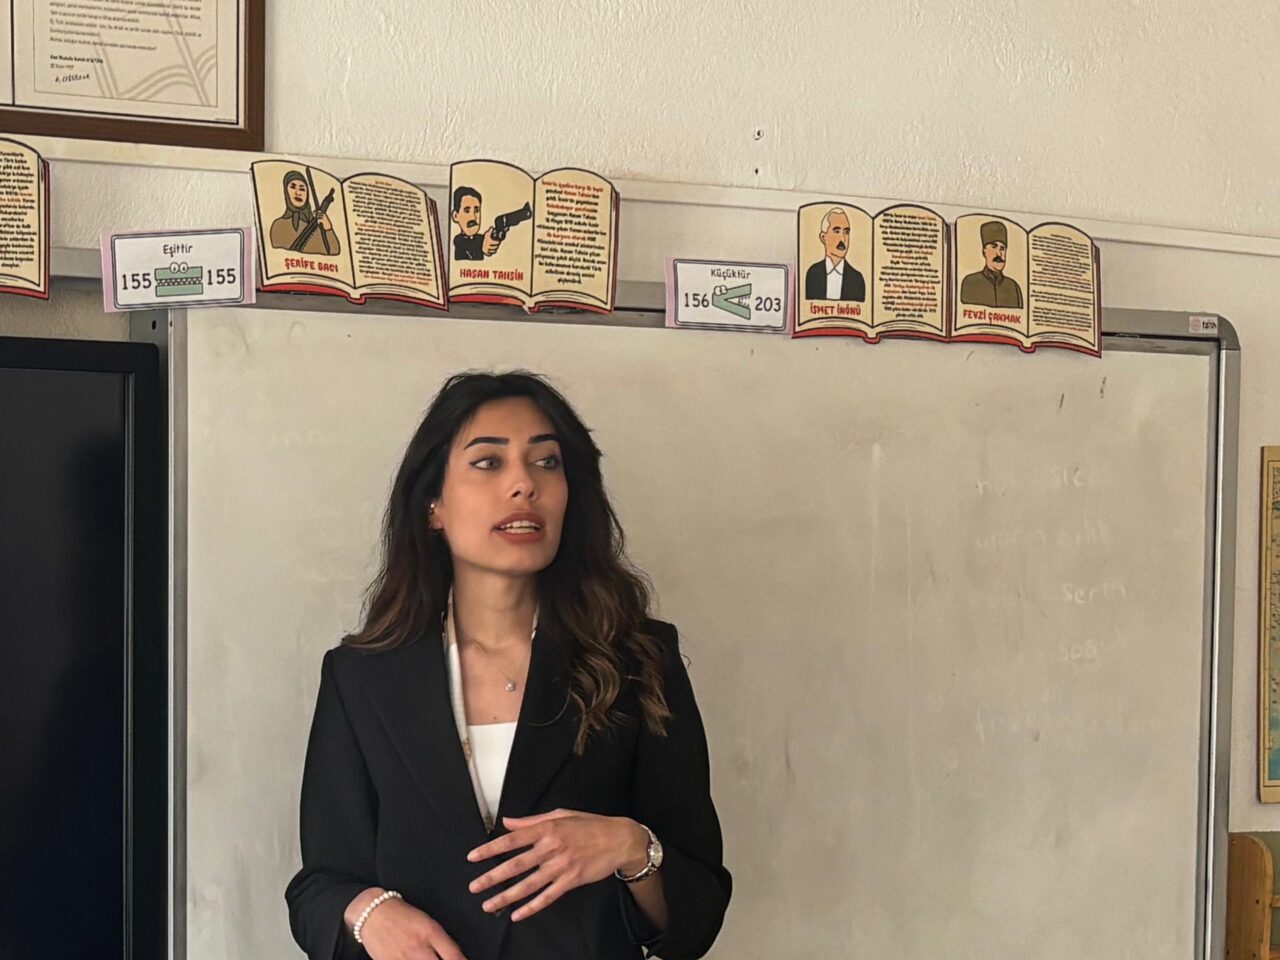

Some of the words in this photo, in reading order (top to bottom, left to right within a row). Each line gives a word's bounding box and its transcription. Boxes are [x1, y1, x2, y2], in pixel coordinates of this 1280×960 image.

[163, 244, 193, 258] Eşittir
[285, 257, 315, 270] ŞERİFE
[122, 273, 152, 290] 155
[207, 268, 236, 285] 155
[460, 268, 489, 279] HASAN
[711, 269, 751, 281] Küçüktür
[685, 293, 709, 308] 156
[755, 297, 781, 312] 203
[810, 302, 835, 314] İSMET
[963, 309, 986, 319] FEVZİ
